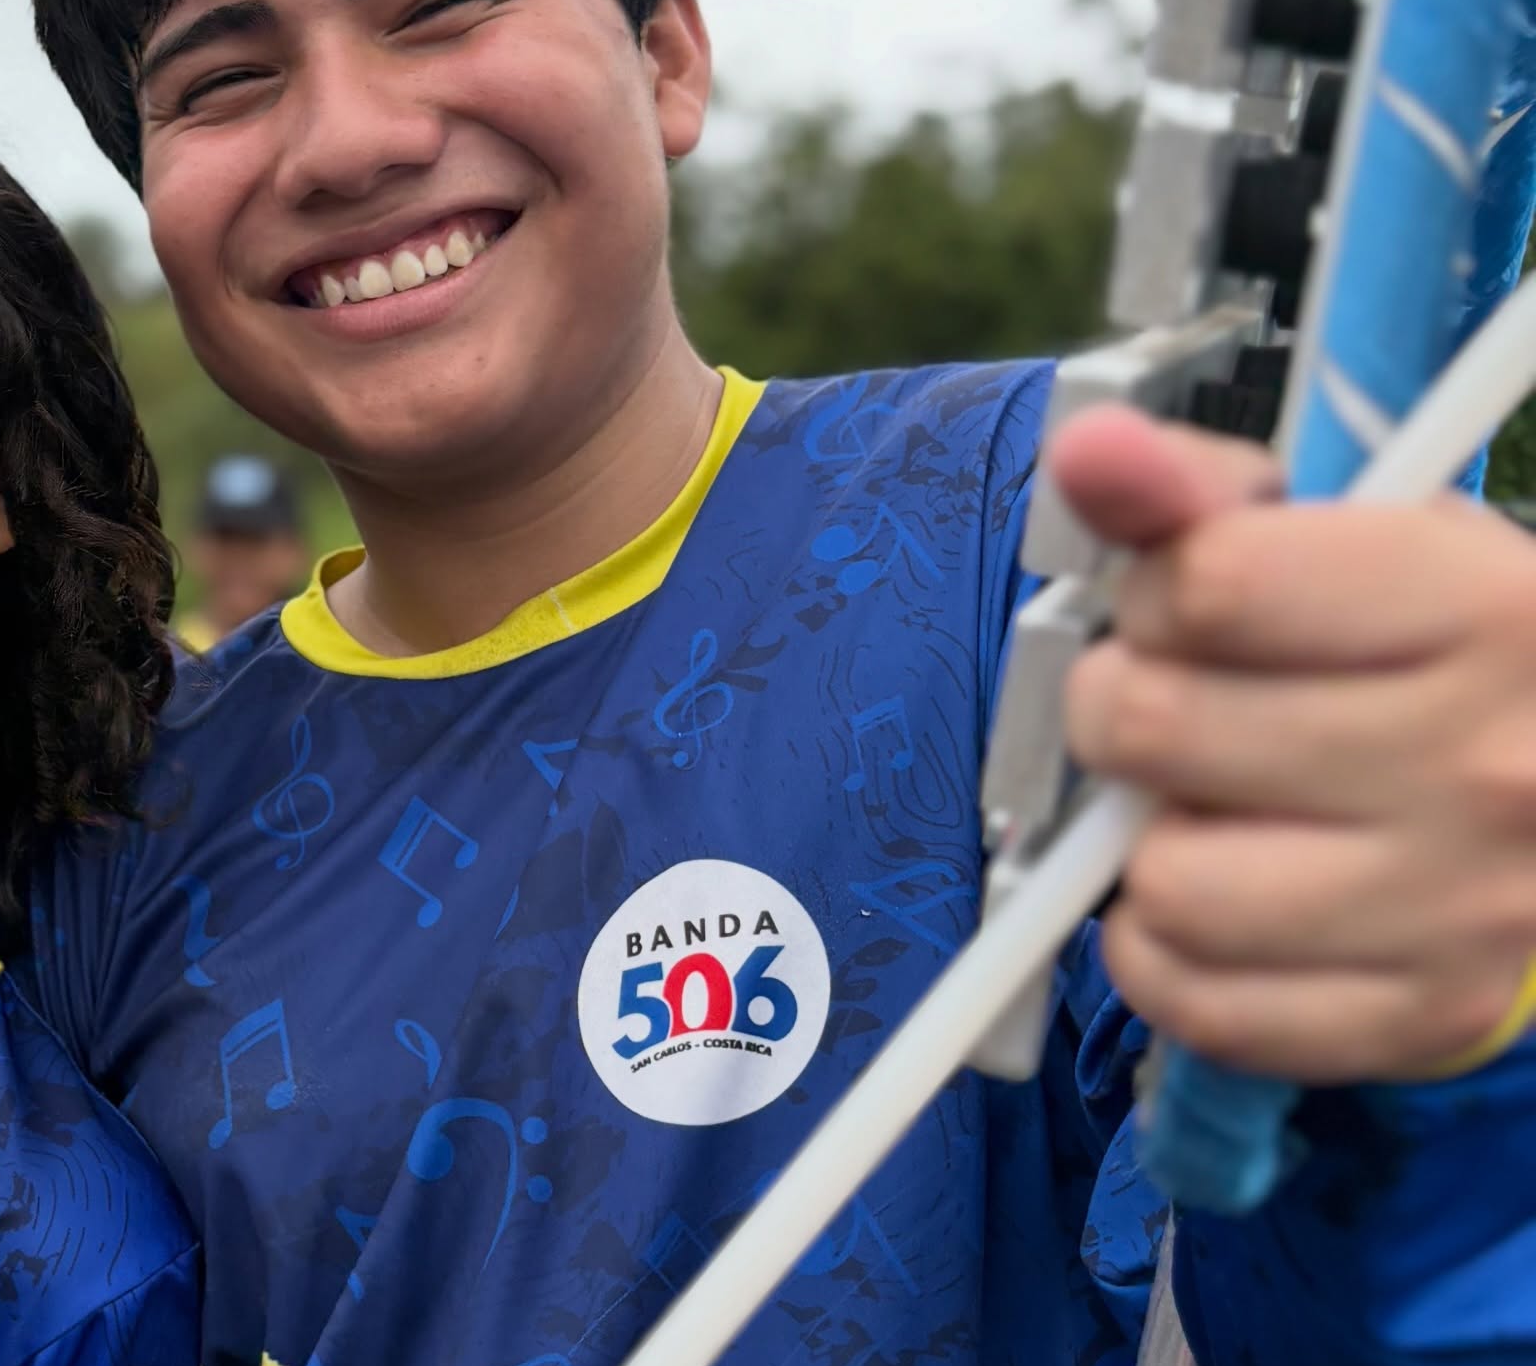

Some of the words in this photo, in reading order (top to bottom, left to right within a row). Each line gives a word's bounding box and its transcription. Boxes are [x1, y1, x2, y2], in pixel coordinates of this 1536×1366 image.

[625, 910, 780, 958] BANDA
[611, 945, 798, 1060] 506
[630, 1056, 652, 1074] SAN
[653, 1040, 692, 1060] CARLOS
[703, 1038, 743, 1051] COSTA
[744, 1041, 773, 1057] RICA
